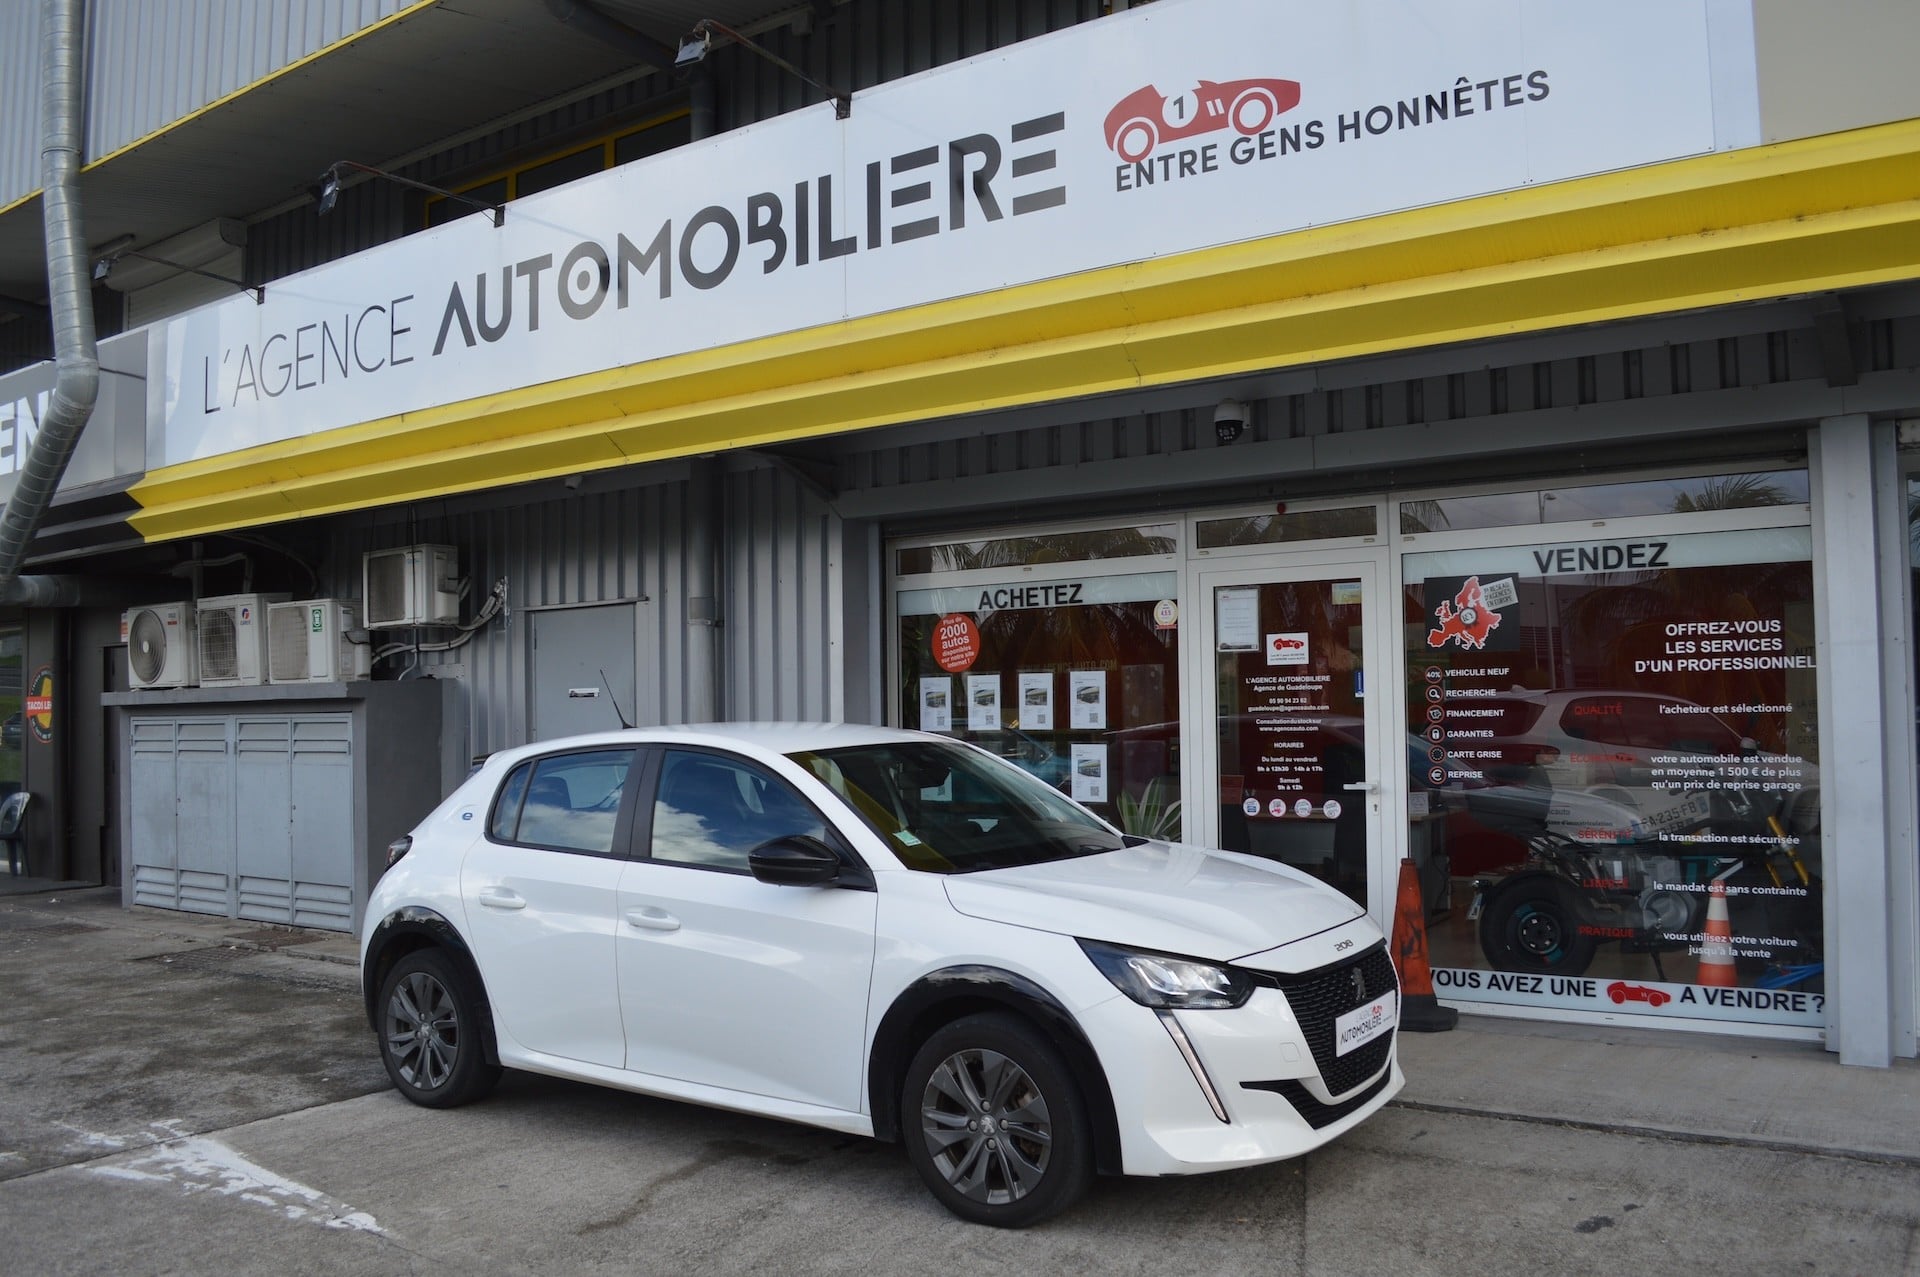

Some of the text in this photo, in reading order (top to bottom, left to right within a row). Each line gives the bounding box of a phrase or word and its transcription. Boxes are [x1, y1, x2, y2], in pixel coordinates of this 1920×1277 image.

[1116, 70, 1551, 192] ENTRE GENS HONNÊTES
[204, 111, 1066, 414] L'AGENCE AUTOMOBILIERE
[1533, 542, 1669, 574] VENDEZ
[978, 583, 1083, 610] ACHETEZ
[940, 622, 968, 640] 2000
[1665, 620, 1781, 636] OFFREZ-VOUS
[942, 635, 970, 649] autos
[1665, 638, 1783, 654] LES SERVICES
[1677, 655, 1817, 672] PROFESSIONNEL
[1445, 668, 1486, 677] VEHICULE
[1487, 667, 1510, 676] NEUF
[1278, 675, 1331, 683] AUTOMOBILIERE
[1446, 689, 1497, 697] RECHERCHE
[1446, 709, 1505, 717] FINANCEMENT
[1575, 703, 1624, 714] QUALITÉ
[1712, 705, 1729, 713] est
[1730, 703, 1793, 713] sélectionné
[1447, 730, 1494, 738] GARANTIES
[1447, 750, 1502, 758] CARTE GRISE
[1651, 754, 1802, 764] votre automobile est vendue
[1447, 770, 1483, 778] REPRISE
[1651, 766, 1801, 778] en moyenne 1 500 € de plus
[1684, 780, 1704, 790] prix
[1706, 780, 1720, 789] de
[1723, 780, 1760, 791] reprise
[1762, 782, 1802, 792] garage
[1578, 827, 1633, 839] SÉRÉNITÉ
[1658, 831, 1800, 844] la transaction est sécurisée
[1653, 880, 1807, 896] le mandat est sans contrainte
[1577, 925, 1634, 939] PRATIQUE
[1334, 939, 1354, 951] 208
[1663, 932, 1798, 947] vous utilisez votre voiture
[1728, 946, 1738, 956] la
[1740, 949, 1771, 959] vente
[1487, 975, 1545, 995] AVEZ
[1550, 978, 1597, 998] UNE
[1679, 986, 1697, 1004] A
[1704, 986, 1807, 1013] VENDRE
